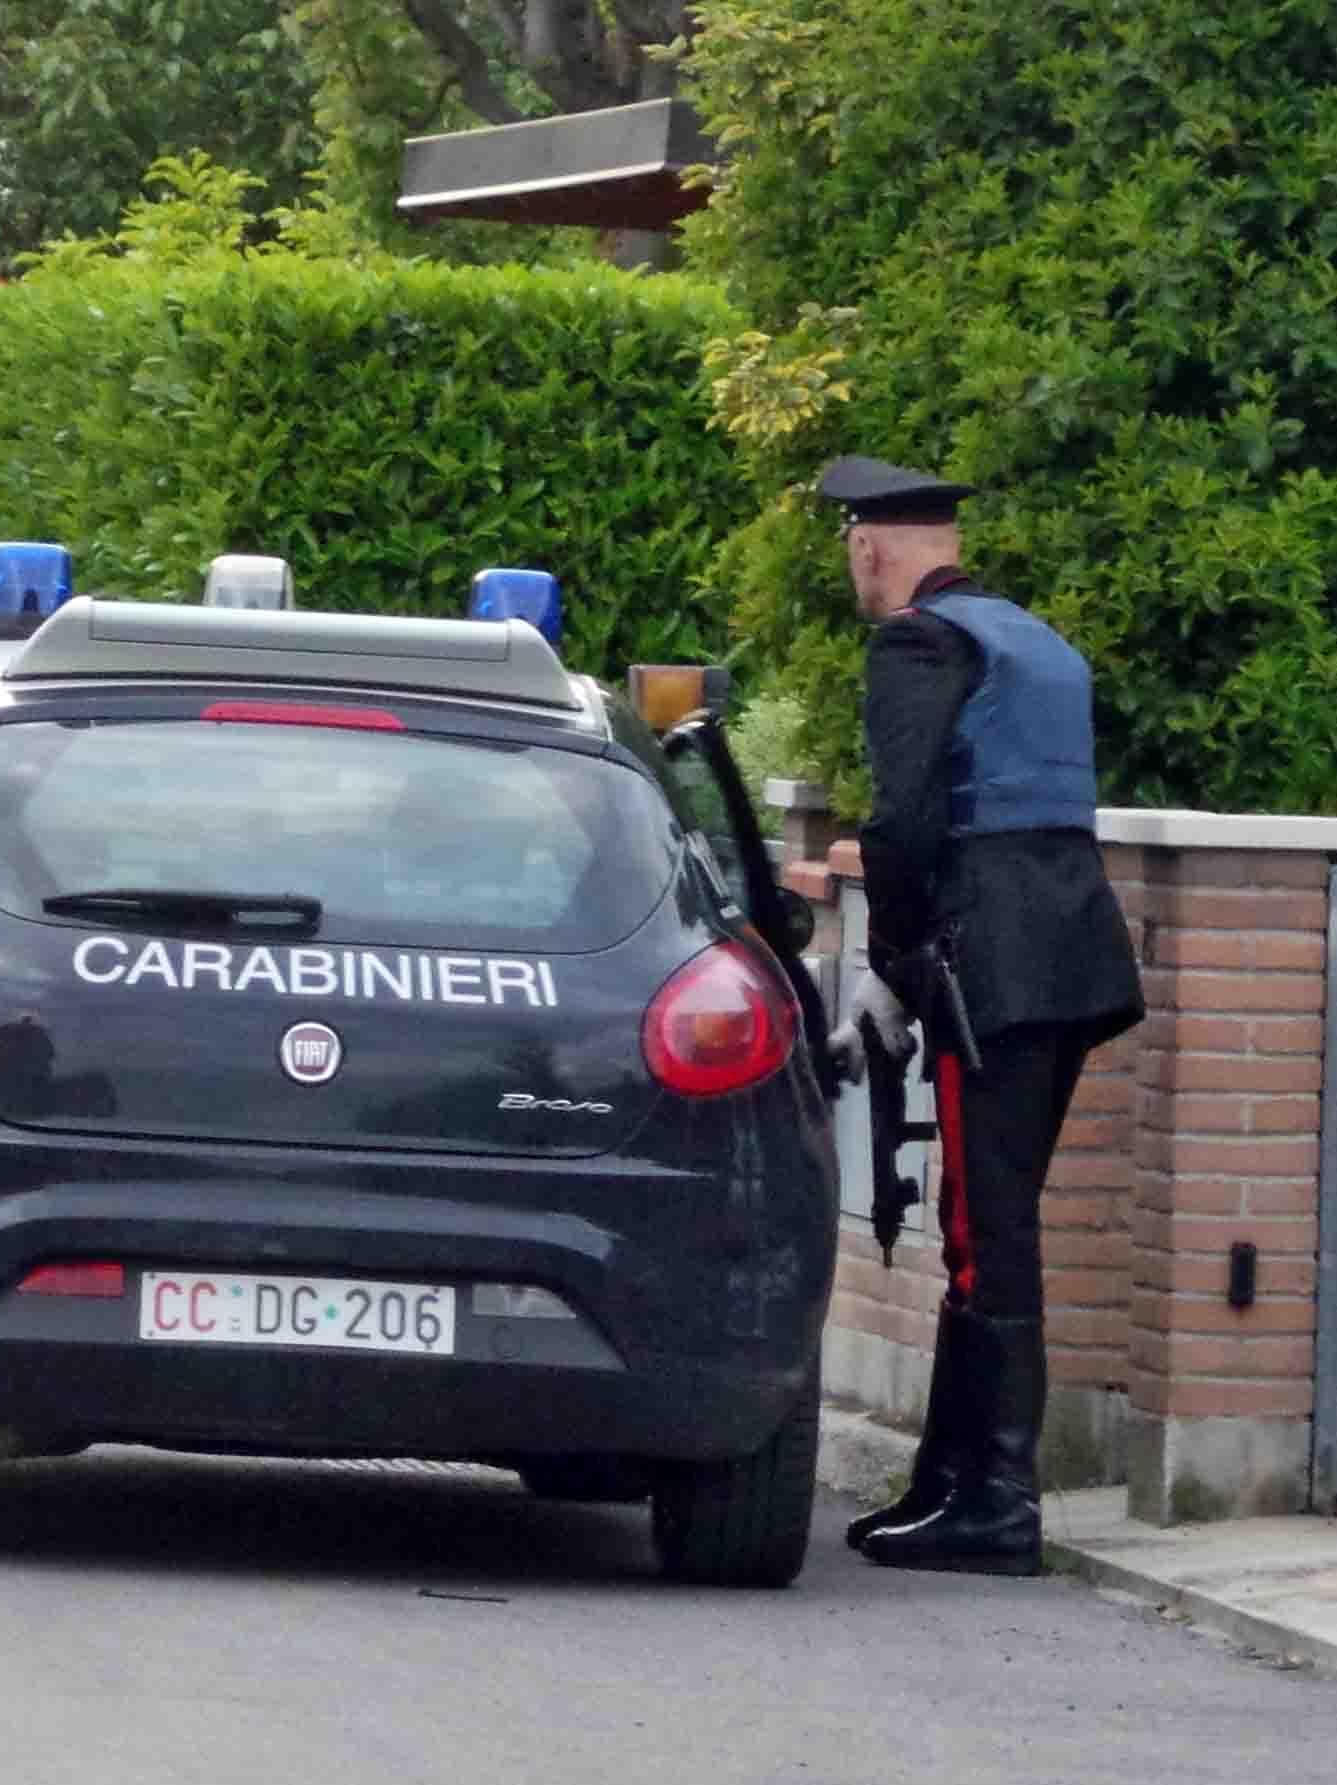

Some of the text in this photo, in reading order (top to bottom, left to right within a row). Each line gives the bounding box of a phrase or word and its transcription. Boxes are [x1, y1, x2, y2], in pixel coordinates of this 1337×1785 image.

[72, 935, 559, 1008] CARABINIERI
[295, 1040, 328, 1066] FIAT
[497, 1093, 614, 1113] Bravo
[152, 1279, 441, 1344] CC DG 206
